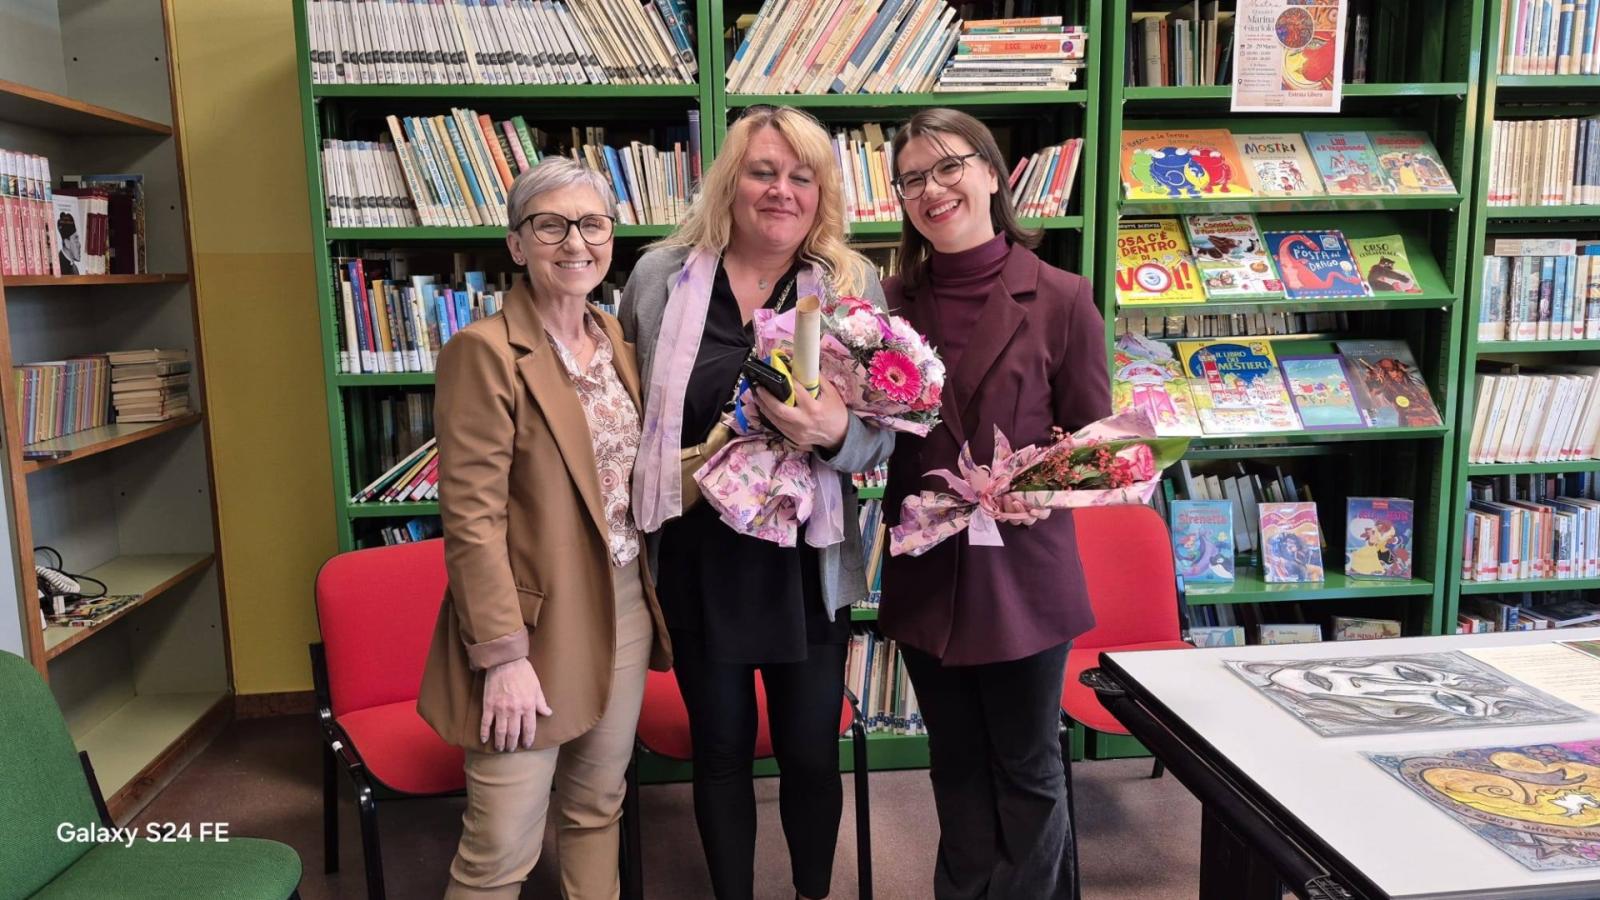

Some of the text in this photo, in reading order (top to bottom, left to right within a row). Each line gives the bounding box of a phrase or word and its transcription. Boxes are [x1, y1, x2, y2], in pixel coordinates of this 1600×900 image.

[1248, 15, 1275, 24] Marina
[449, 129, 468, 164] INPUT
[498, 134, 516, 168] INPUT
[519, 127, 538, 163] INPUT
[1244, 143, 1297, 155] MOSTRI
[1204, 221, 1234, 229] Conosci
[1117, 235, 1144, 248] OSA
[1121, 240, 1177, 257] DENTRO
[1294, 248, 1330, 260] POSTA
[1309, 260, 1339, 272] DRAGO
[1218, 362, 1268, 370] MESTIERI
